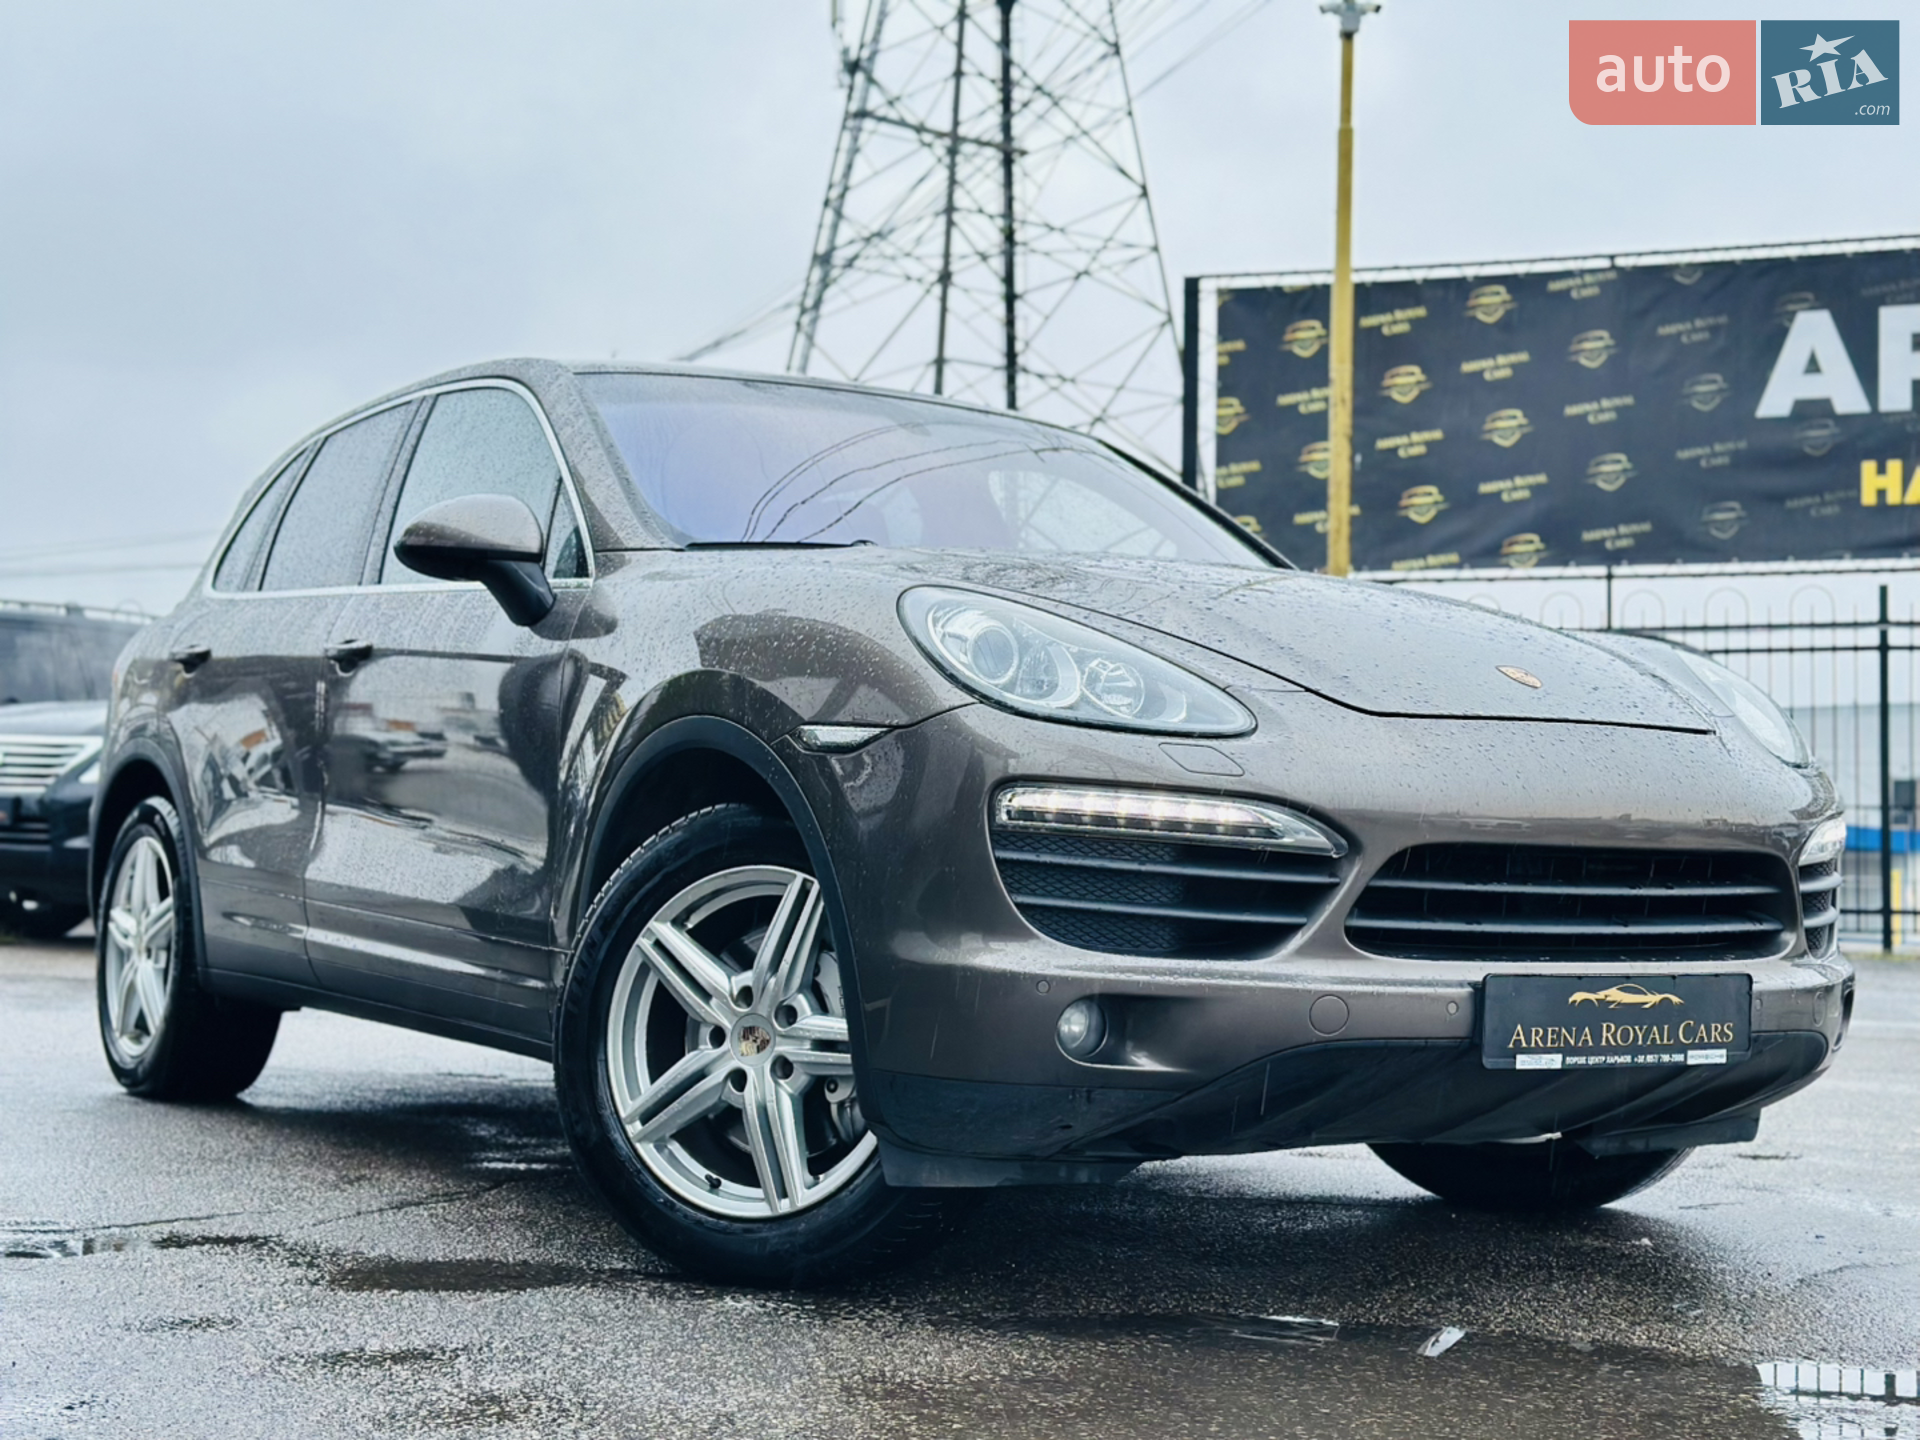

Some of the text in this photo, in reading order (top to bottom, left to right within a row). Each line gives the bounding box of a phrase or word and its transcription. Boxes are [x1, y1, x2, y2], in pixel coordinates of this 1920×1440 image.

[1508, 1020, 1734, 1049] ARENA ROYAL CARS
